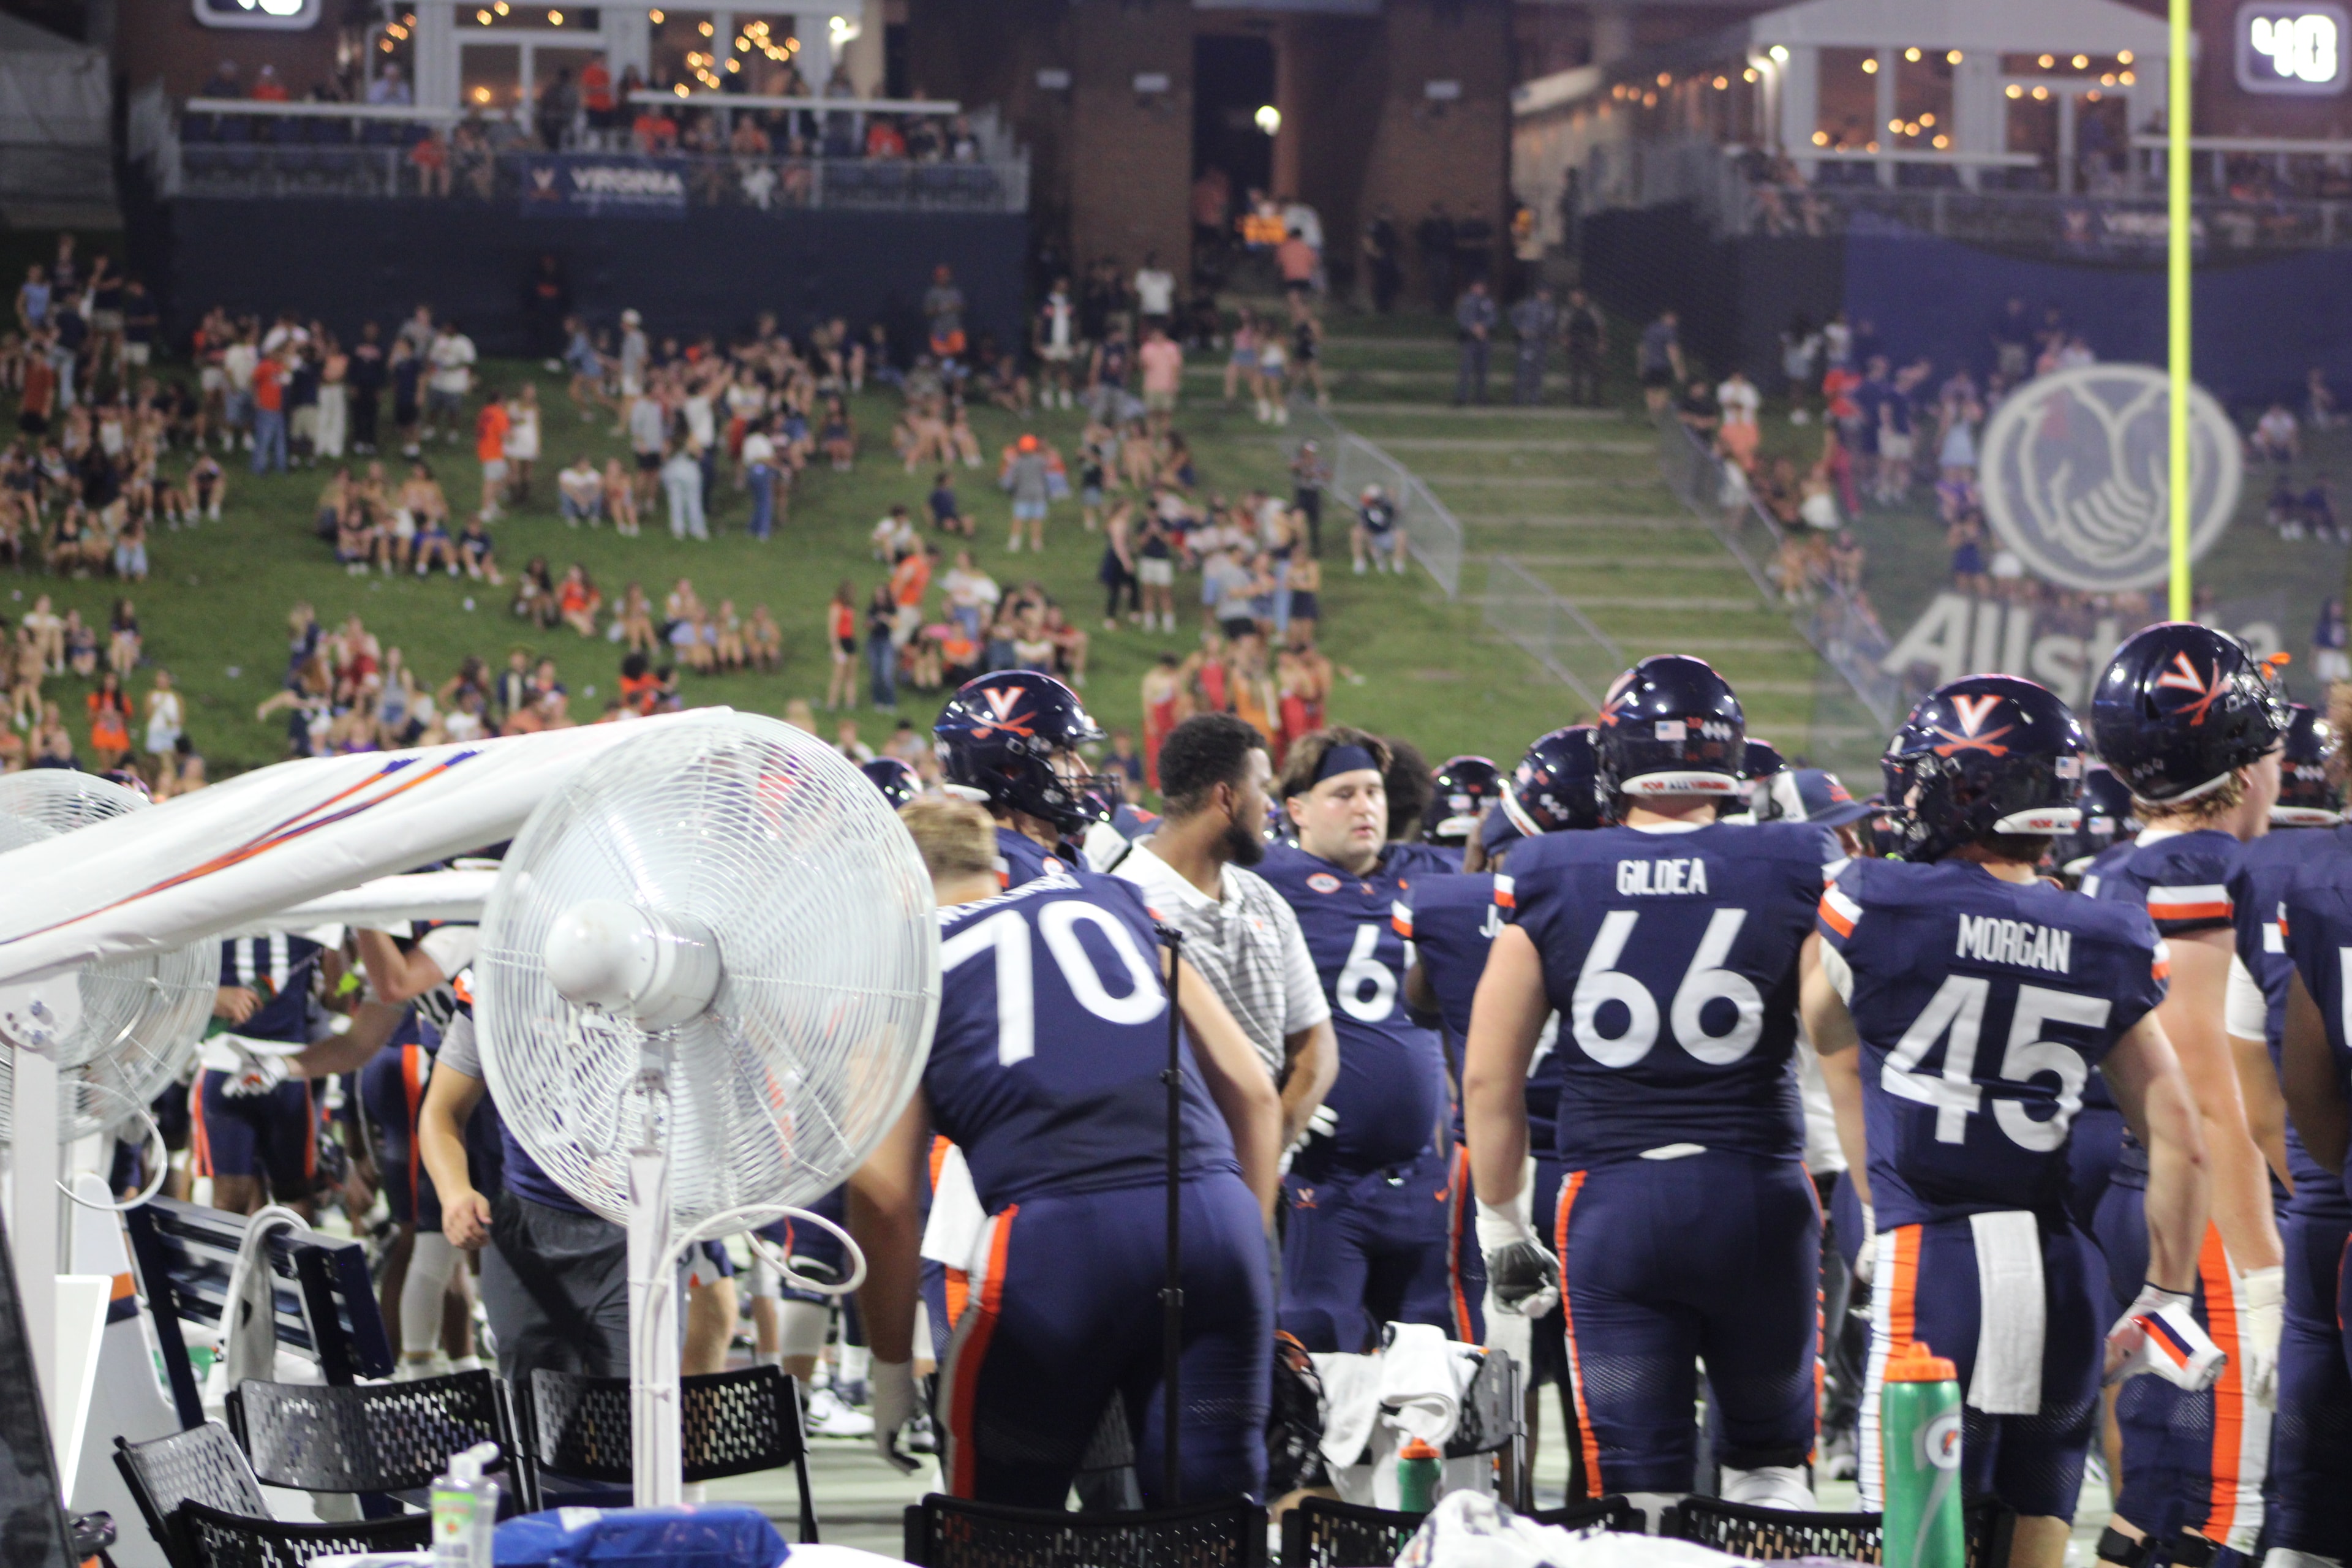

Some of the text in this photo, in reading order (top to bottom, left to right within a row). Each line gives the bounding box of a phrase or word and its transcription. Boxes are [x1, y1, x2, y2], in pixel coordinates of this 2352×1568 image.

[2250, 14, 2337, 82] 40
[1615, 857, 1708, 896] GILDEA
[940, 900, 1168, 1068] 70
[1570, 907, 1765, 1069] 66
[1955, 913, 2072, 981] MORGAN
[1880, 973, 2113, 1153] 45
